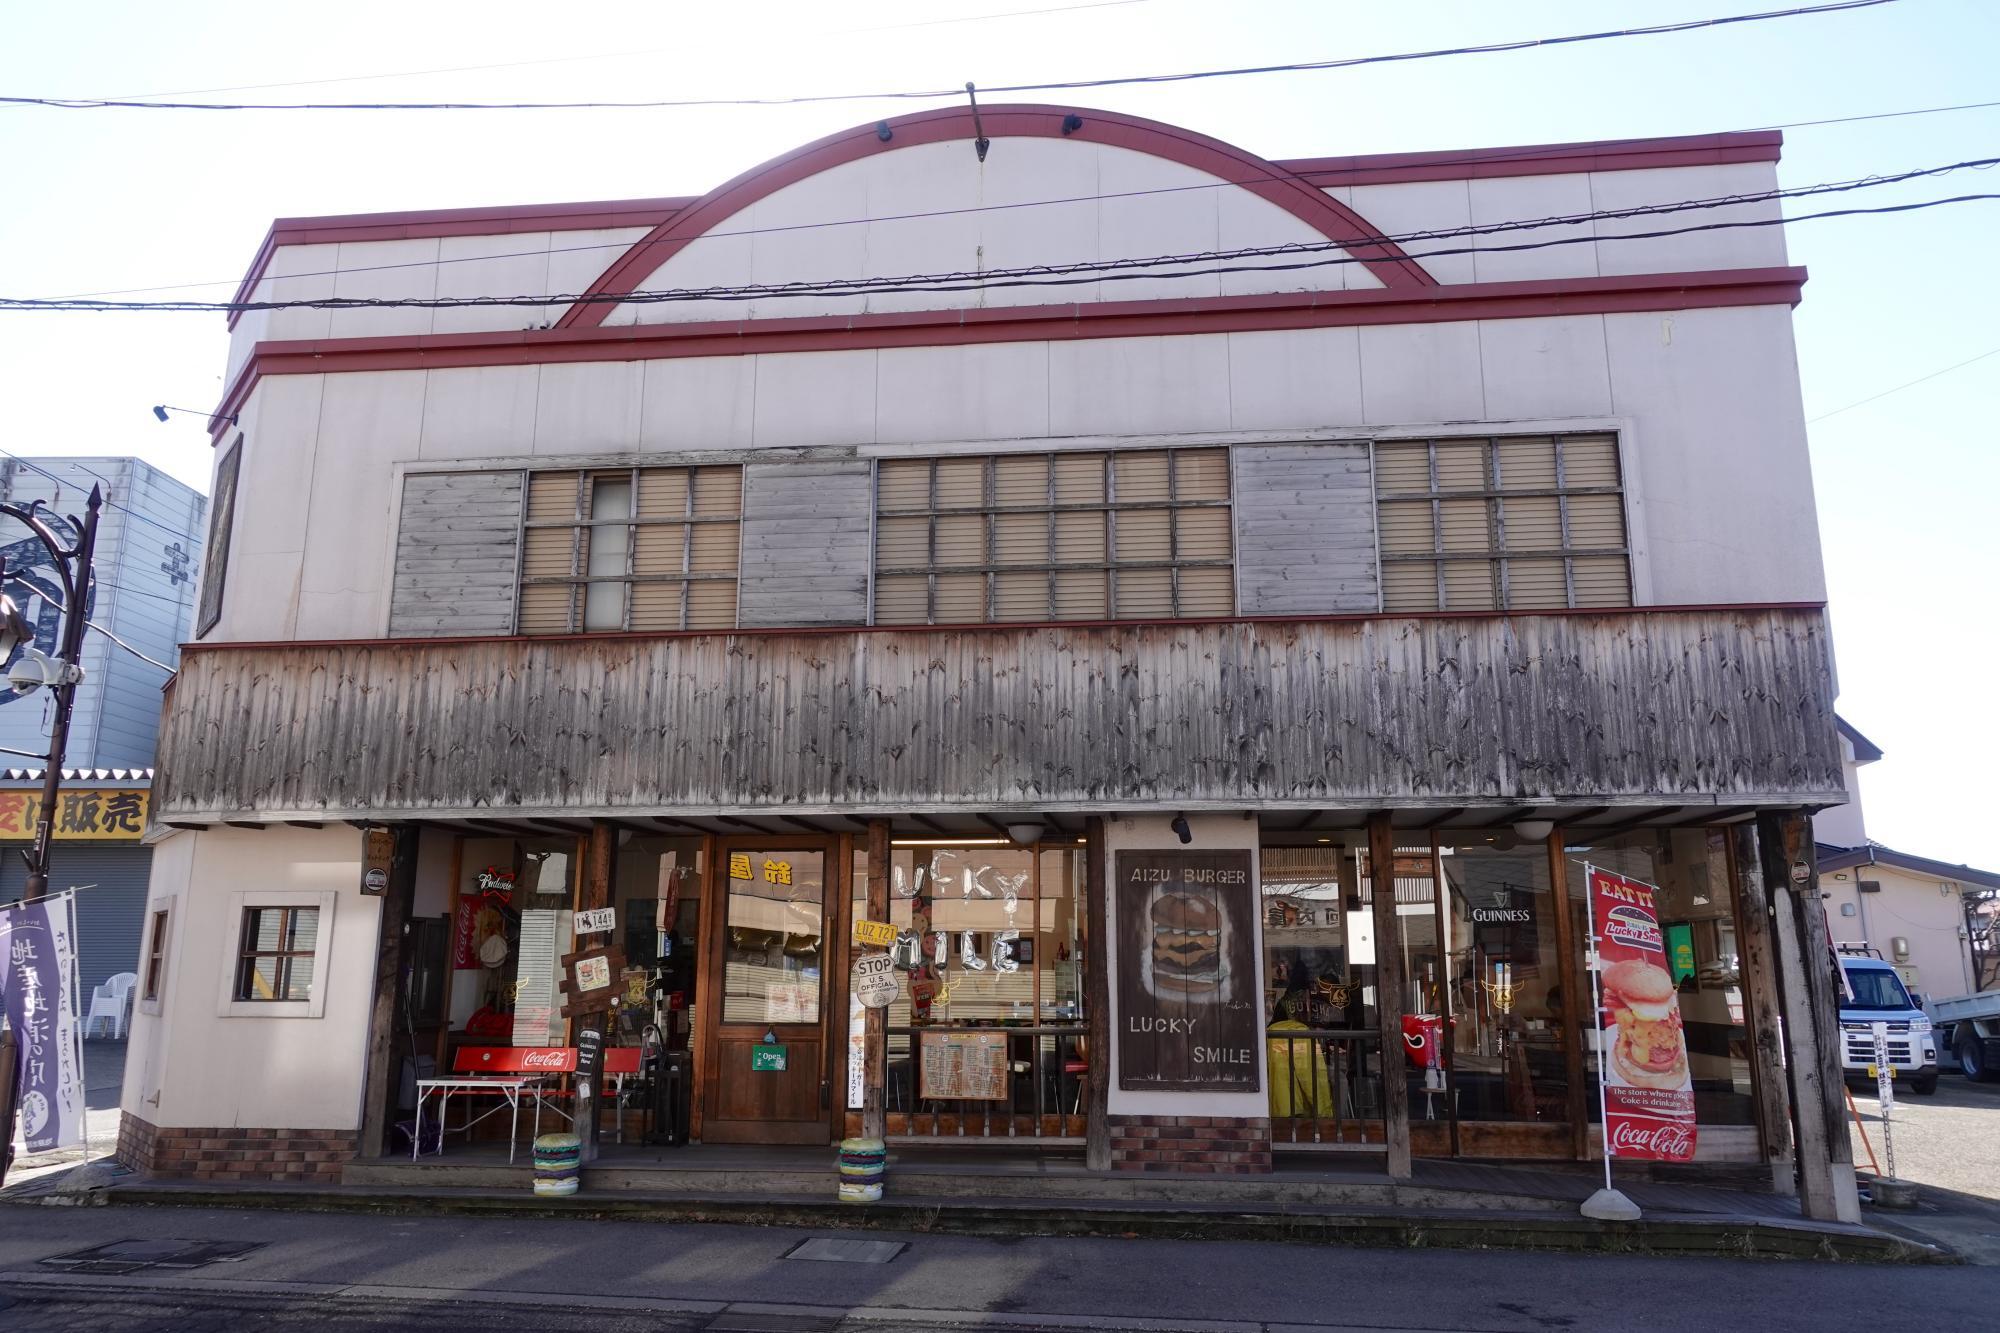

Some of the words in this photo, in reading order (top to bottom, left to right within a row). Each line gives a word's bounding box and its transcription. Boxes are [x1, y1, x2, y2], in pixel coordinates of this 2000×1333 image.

[893, 848, 1029, 915] UCKY
[1130, 868, 1171, 882] AIZU
[1184, 868, 1246, 884] BURGER
[1599, 879, 1636, 904] EAT
[1637, 891, 1655, 908] IT
[1473, 907, 1530, 923] GUINNESS
[856, 922, 876, 937] LUZ
[1606, 923, 1637, 939] Lucky
[858, 958, 891, 975] STOP
[861, 980, 894, 991] OFFICIAL
[1130, 1016, 1197, 1035] LUCKY
[524, 1050, 567, 1067] Coca-Cola
[762, 1052, 781, 1062] Open
[1193, 1046, 1251, 1064] SMILE
[1621, 1097, 1640, 1105] Coke
[1650, 1090, 1672, 1098] where
[1613, 1121, 1690, 1155] Coca-Cola
